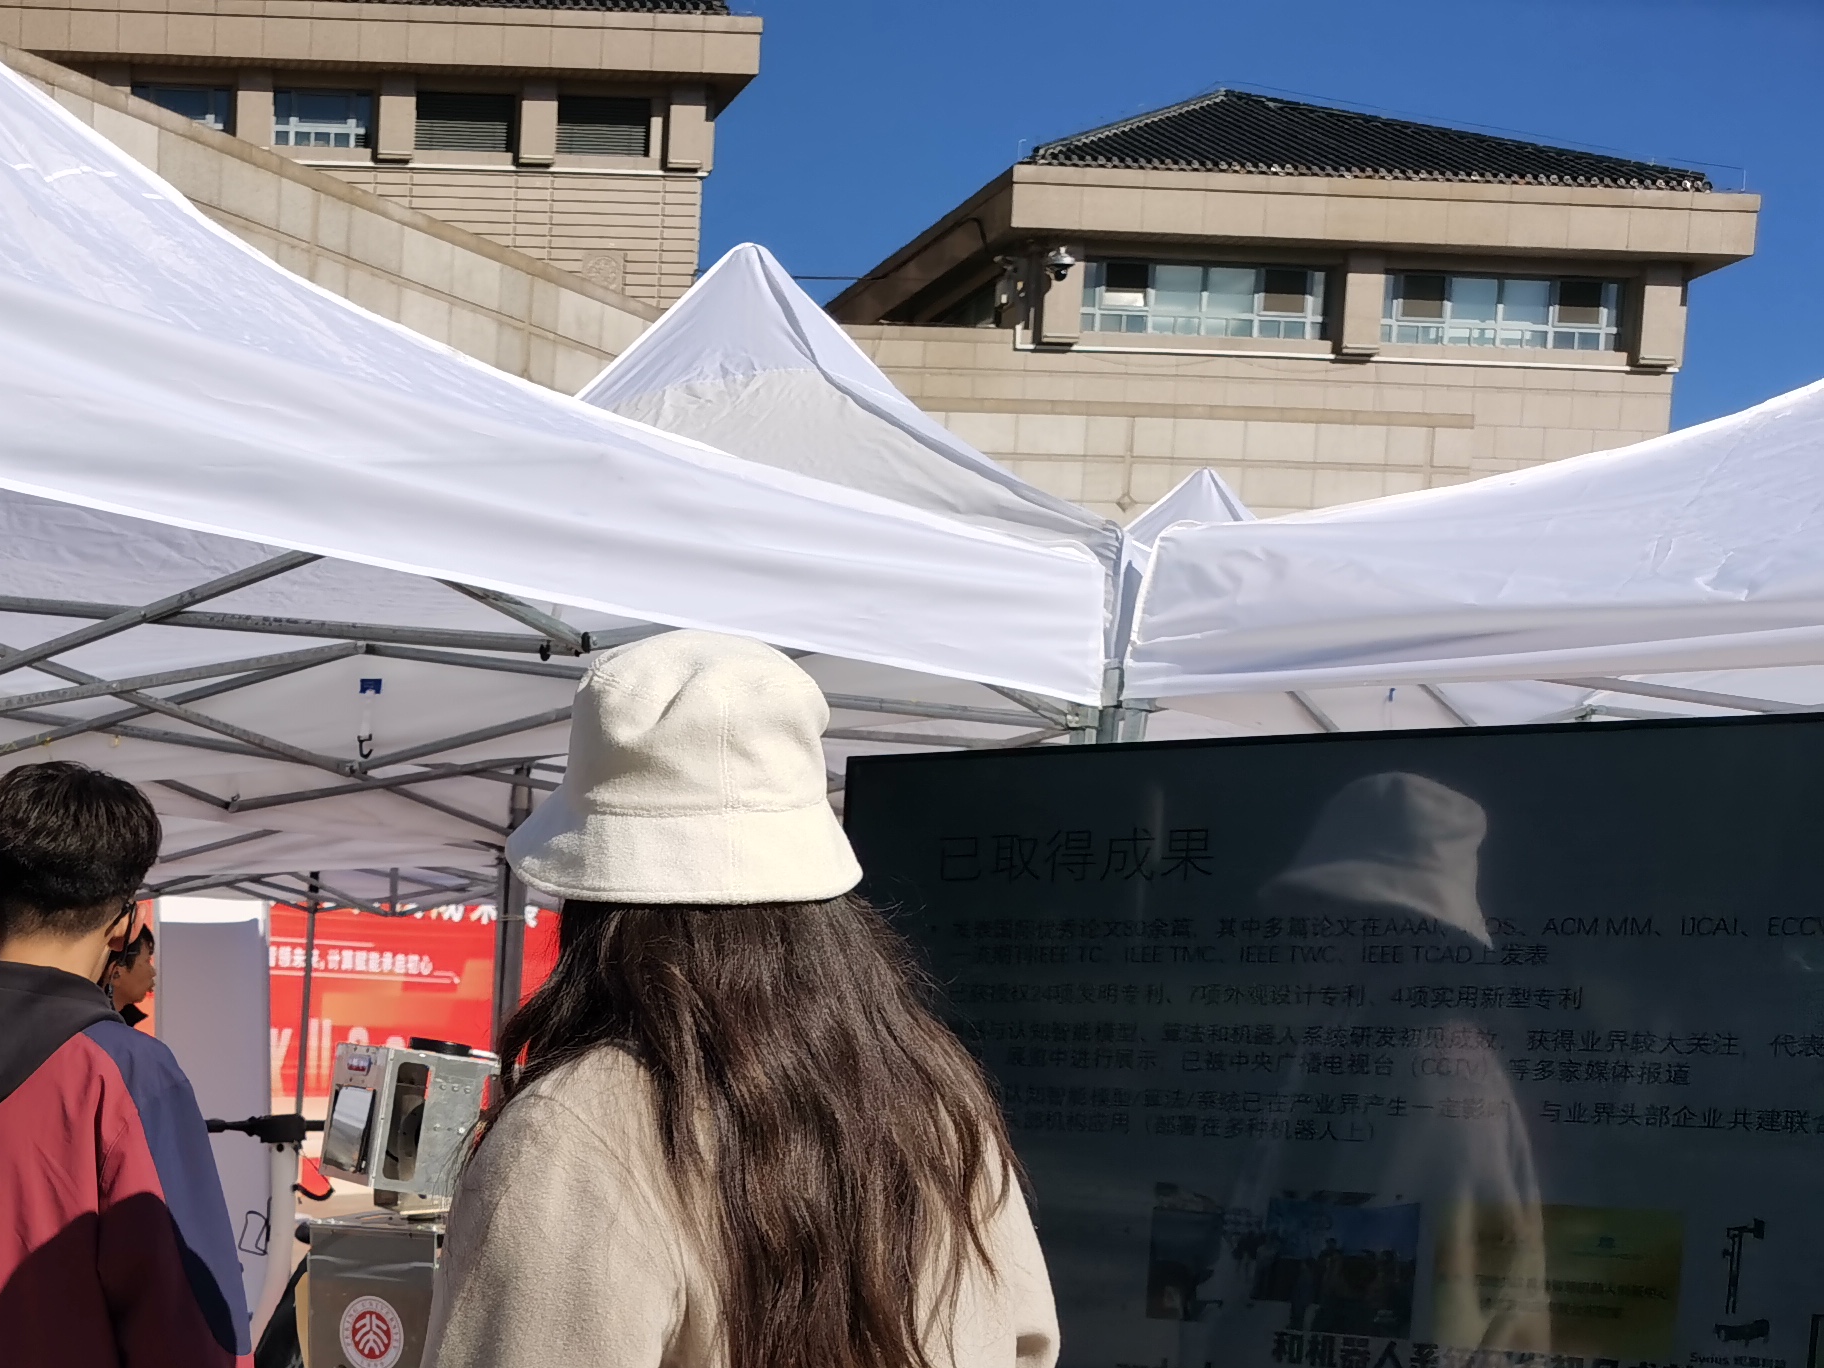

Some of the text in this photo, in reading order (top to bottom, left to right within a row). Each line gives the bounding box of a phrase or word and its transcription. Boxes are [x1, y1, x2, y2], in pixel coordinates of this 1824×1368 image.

[939, 824, 1214, 884] 已取得成果
